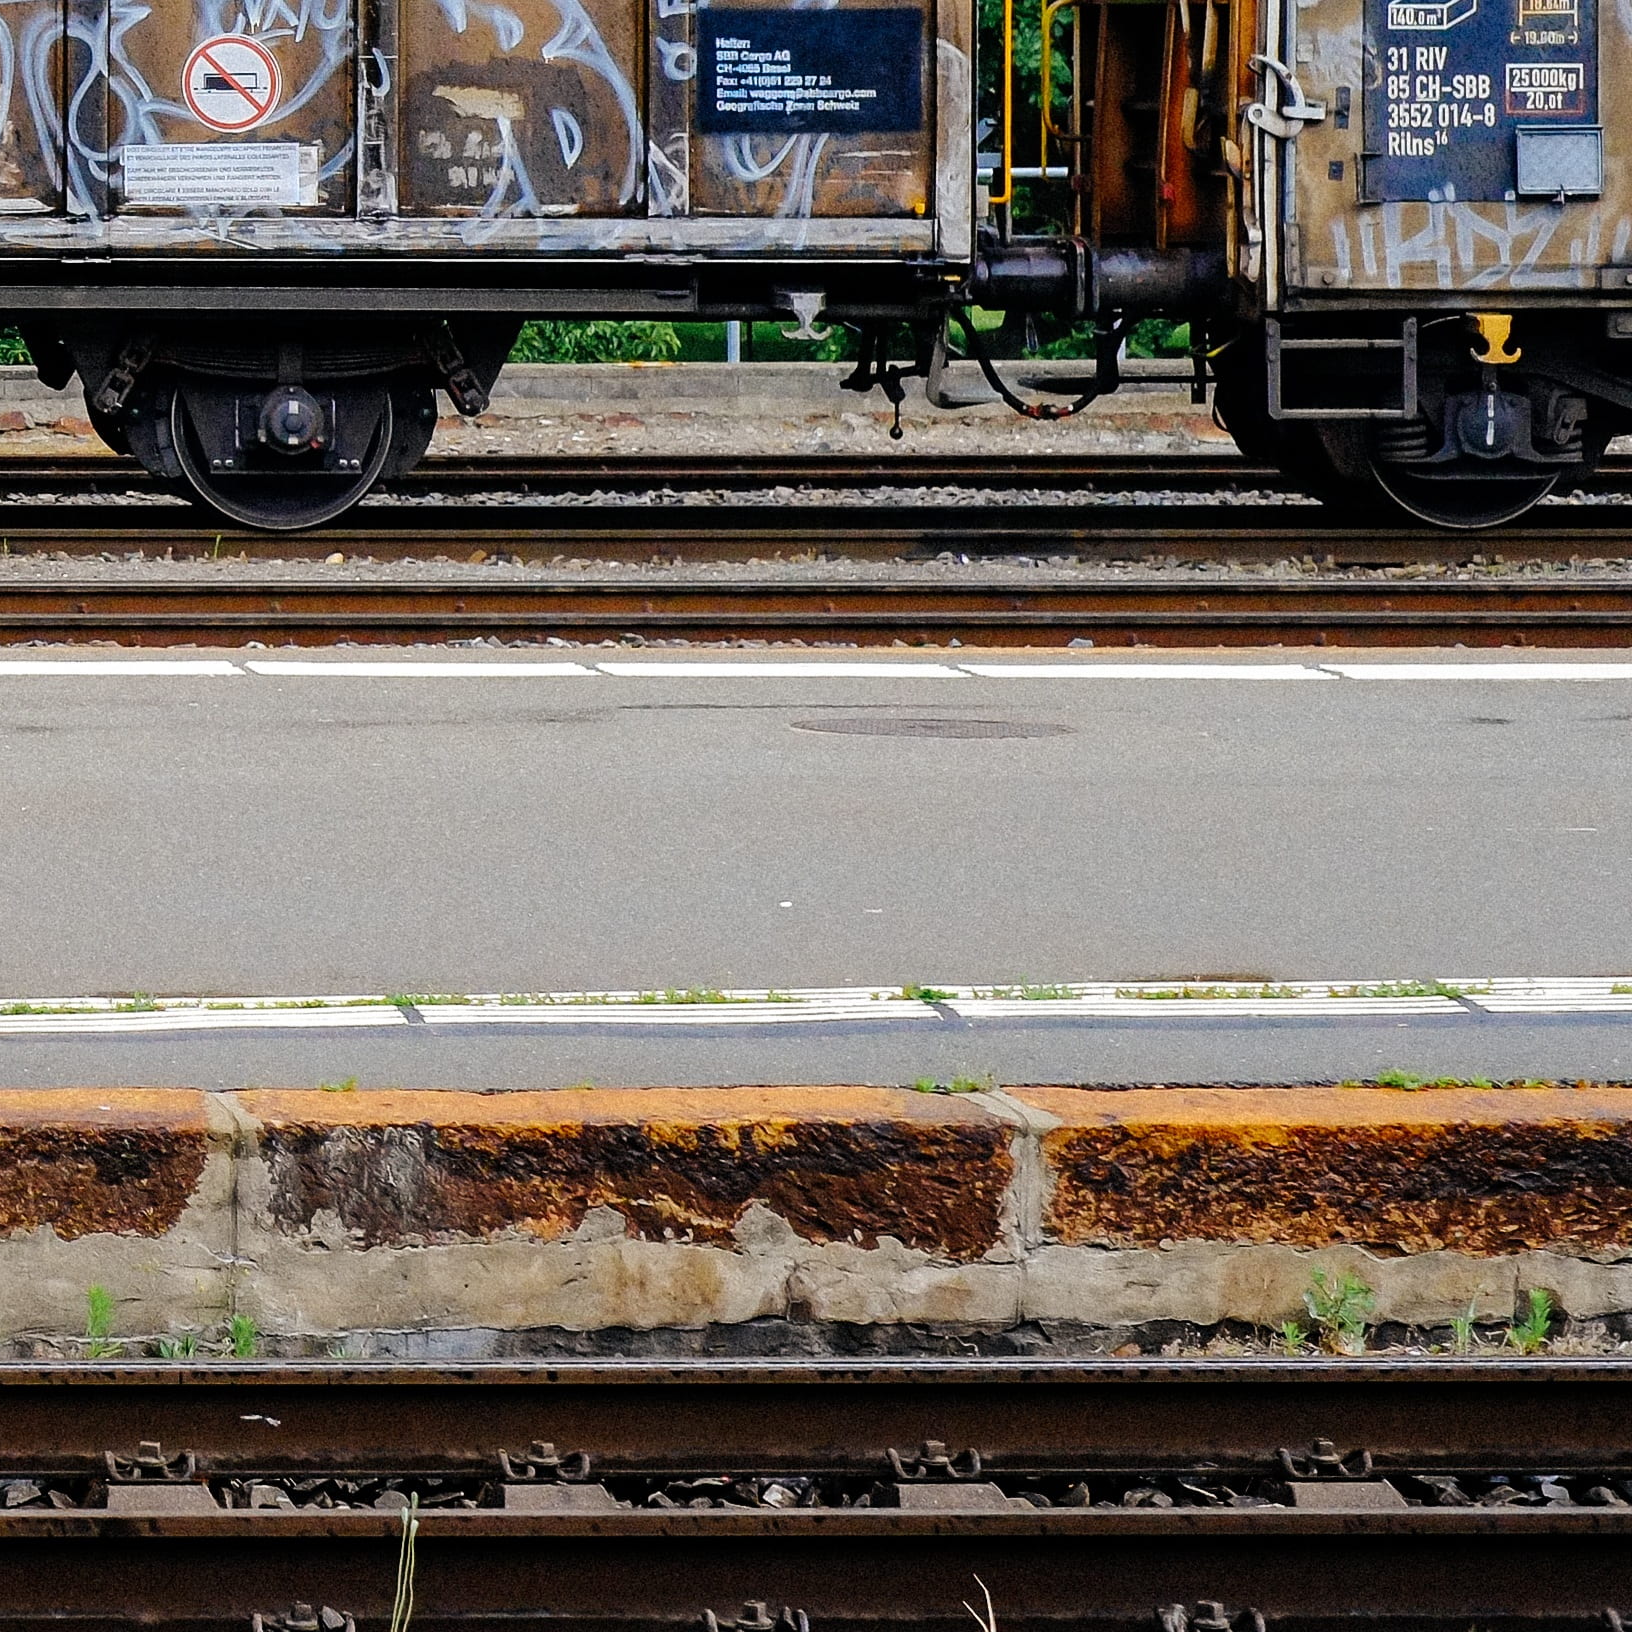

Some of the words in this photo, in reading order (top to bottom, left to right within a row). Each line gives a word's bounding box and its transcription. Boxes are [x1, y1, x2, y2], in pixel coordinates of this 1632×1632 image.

[740, 51, 772, 63] Cargo
[774, 50, 791, 61] AG
[1387, 47, 1408, 72] 31
[1415, 46, 1448, 72] RIV
[1387, 75, 1410, 100] 85
[1415, 74, 1491, 101] CH-SBB
[1438, 103, 1496, 128] 014-8
